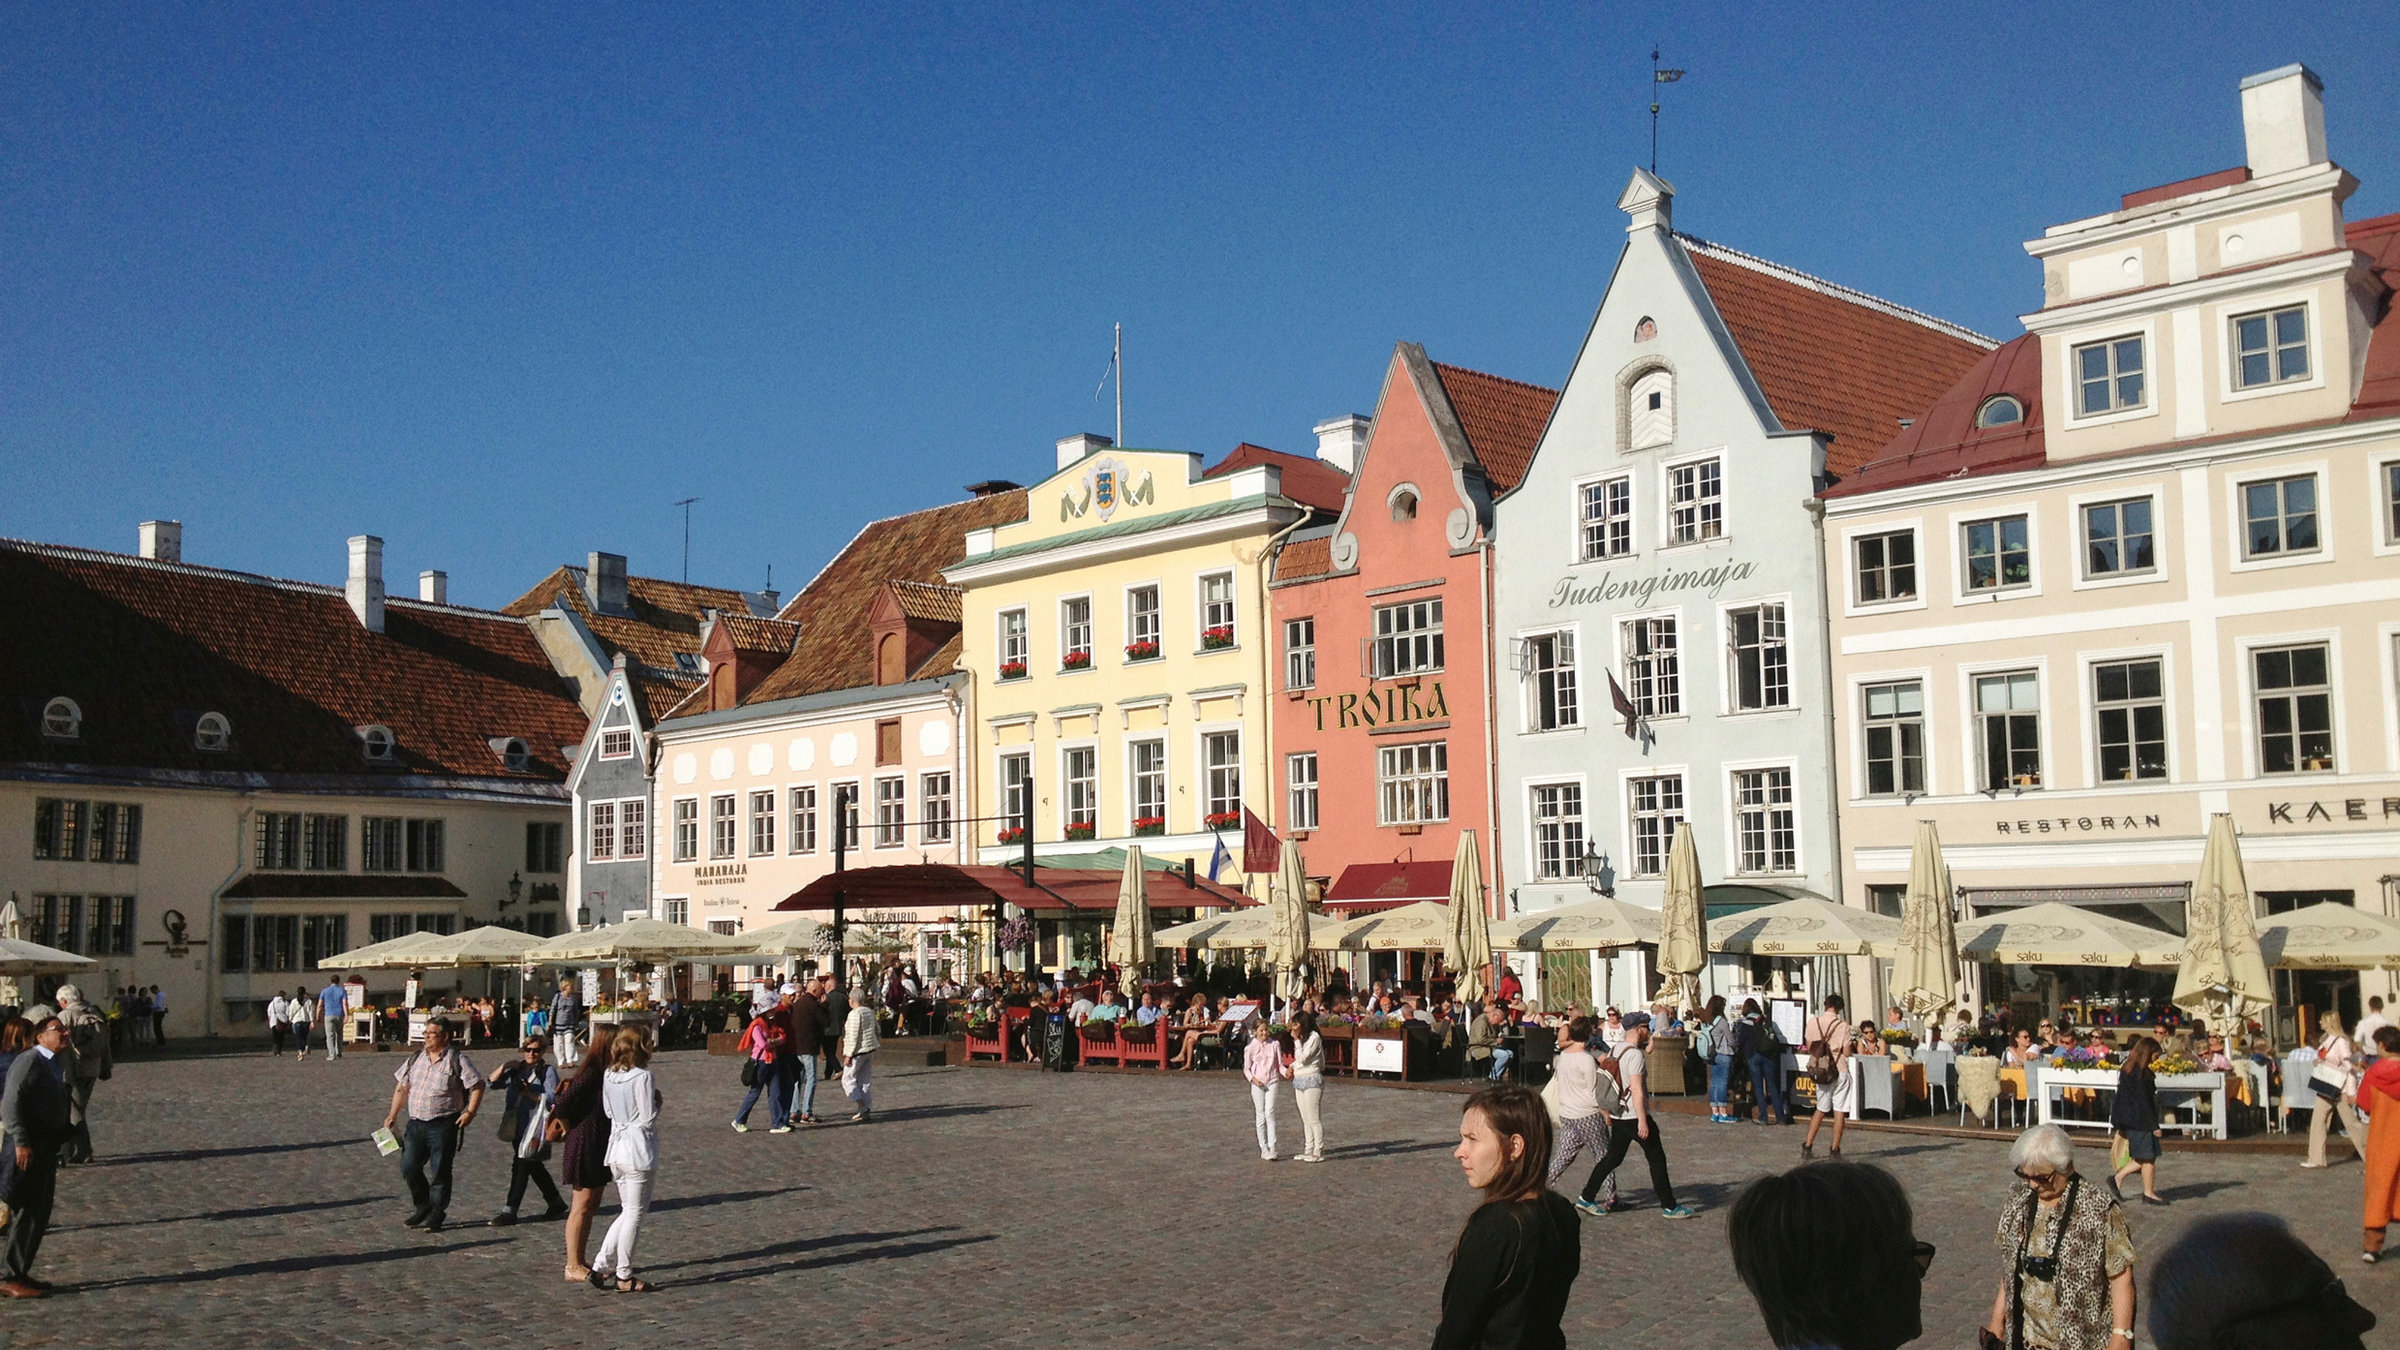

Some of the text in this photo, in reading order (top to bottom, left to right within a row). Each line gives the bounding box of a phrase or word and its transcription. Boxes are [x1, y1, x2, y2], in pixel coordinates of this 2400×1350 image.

[1549, 557, 1759, 609] Tudengimaja
[1306, 682, 1450, 731] TROIKA
[1997, 814, 2160, 835] RESTORAN
[694, 864, 747, 878] MAHARAJA
[1380, 937, 1399, 947] saku
[1423, 937, 1441, 946] saku
[1554, 938, 1573, 948] saku
[1600, 937, 1620, 947] saku
[1709, 940, 1731, 951] saku
[1762, 941, 1785, 951] saku
[1816, 940, 1839, 951] saku
[2016, 950, 2043, 962] saku
[2081, 952, 2108, 964] saku
